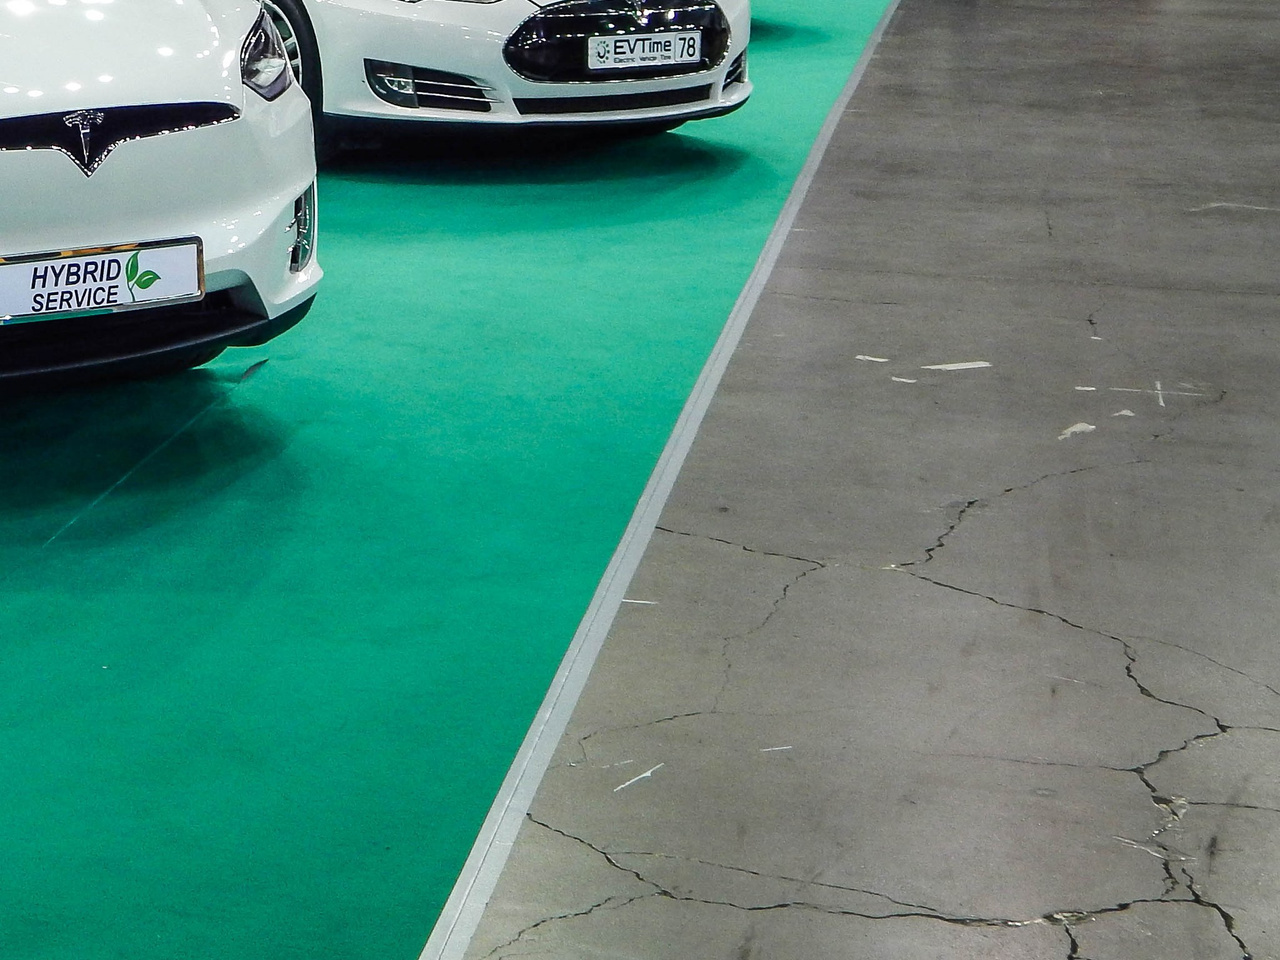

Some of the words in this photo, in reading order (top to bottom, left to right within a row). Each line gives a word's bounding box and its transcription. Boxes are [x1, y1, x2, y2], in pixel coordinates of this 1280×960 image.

[613, 38, 672, 55] EVTime
[678, 36, 696, 58] 78
[30, 258, 122, 290] HYBRID
[31, 284, 120, 313] SERVICE
